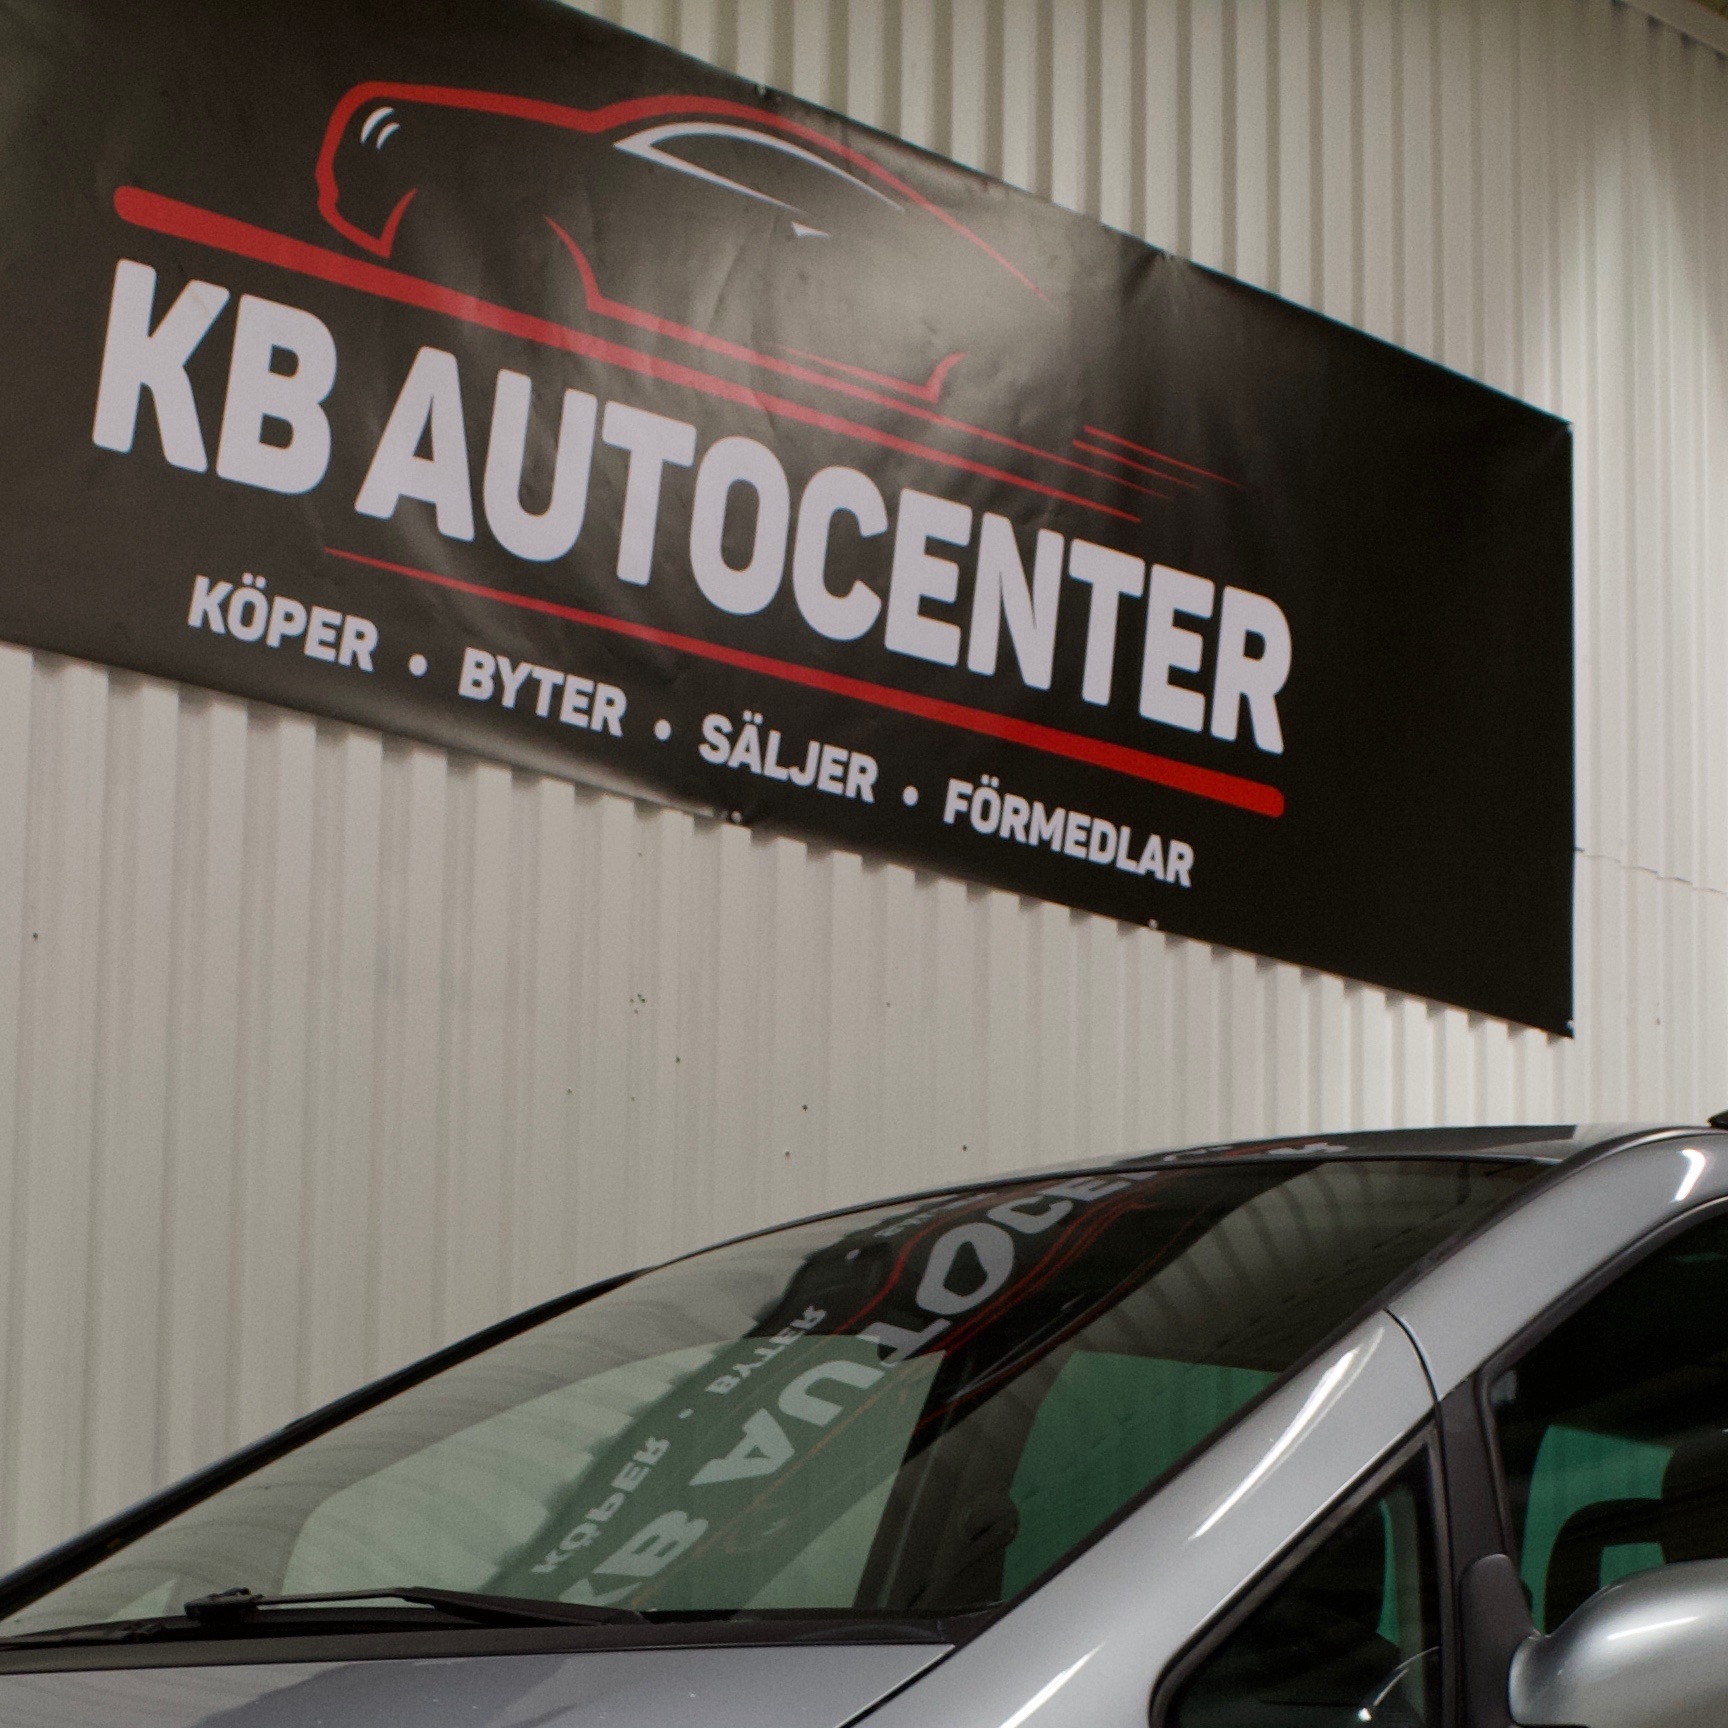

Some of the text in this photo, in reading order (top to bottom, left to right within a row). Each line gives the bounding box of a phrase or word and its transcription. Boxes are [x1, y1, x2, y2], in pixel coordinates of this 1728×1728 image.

[92, 259, 1292, 755] KB AUTOCENTER
[187, 572, 1194, 887] KÖPER BYTER SÄLJER FÖRMEDLAR
